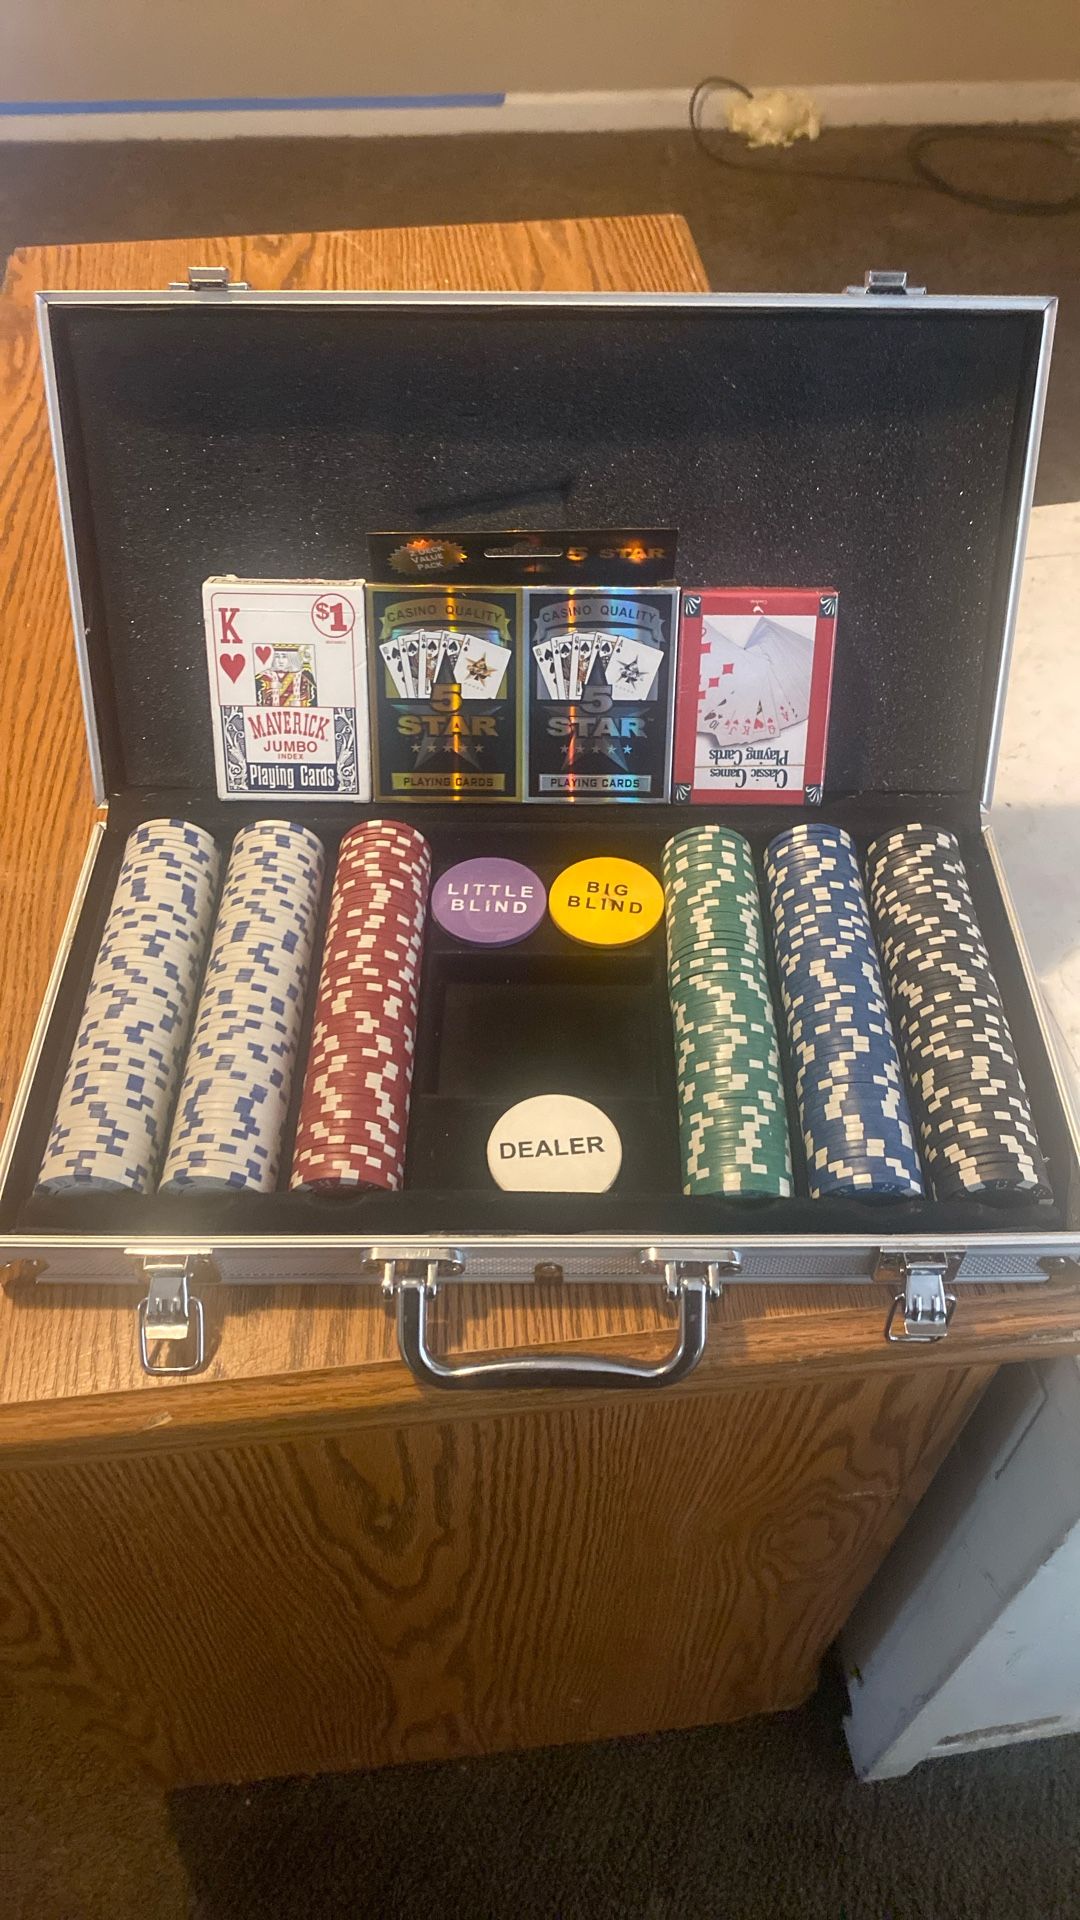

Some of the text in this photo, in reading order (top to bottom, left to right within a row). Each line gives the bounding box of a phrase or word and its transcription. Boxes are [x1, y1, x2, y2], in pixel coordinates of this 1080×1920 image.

[410, 553, 444, 563] VALUE
[567, 546, 666, 561] 5 STAR
[417, 562, 443, 571] PACK
[316, 602, 347, 632] $1
[387, 605, 502, 622] CASINO QUALITY
[542, 605, 656, 622] CASINO QUALITY
[218, 608, 243, 644] K
[431, 683, 463, 713] 5
[581, 684, 614, 714] 5
[247, 711, 330, 741] MAVERICK
[396, 714, 499, 737] STAR
[545, 715, 648, 739] STAR
[263, 740, 318, 753] JUMBO
[708, 746, 790, 767] Playing Cards
[249, 764, 335, 789] Playing Cards
[403, 777, 494, 787] PLAYING CARDS
[550, 778, 640, 788] PLAYING CARDS
[709, 768, 789, 789] Classic Games
[447, 882, 534, 898] LITTLE
[586, 880, 629, 896] BIG
[450, 898, 528, 914] BLIND
[567, 894, 643, 914] BLIND
[499, 1135, 606, 1160] DEALER
